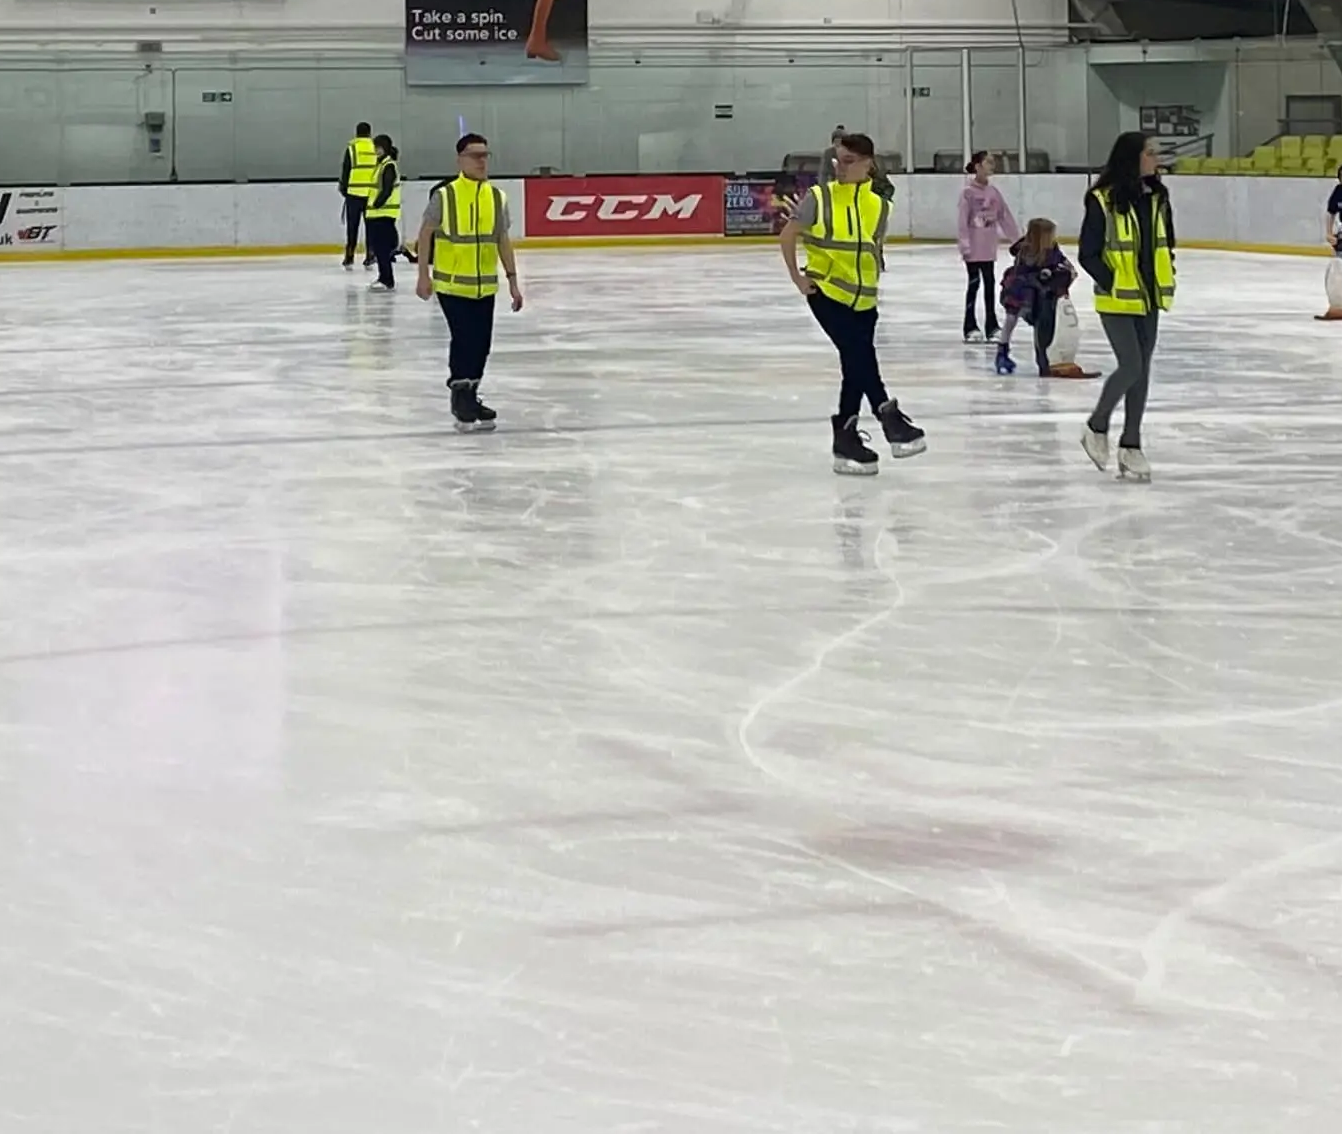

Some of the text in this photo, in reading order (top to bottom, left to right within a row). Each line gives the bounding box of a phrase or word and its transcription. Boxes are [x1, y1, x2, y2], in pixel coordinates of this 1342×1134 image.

[411, 9, 452, 23] Take
[456, 12, 466, 23] a
[411, 26, 441, 40] Cut
[446, 28, 490, 40] some
[546, 193, 703, 221] CCM
